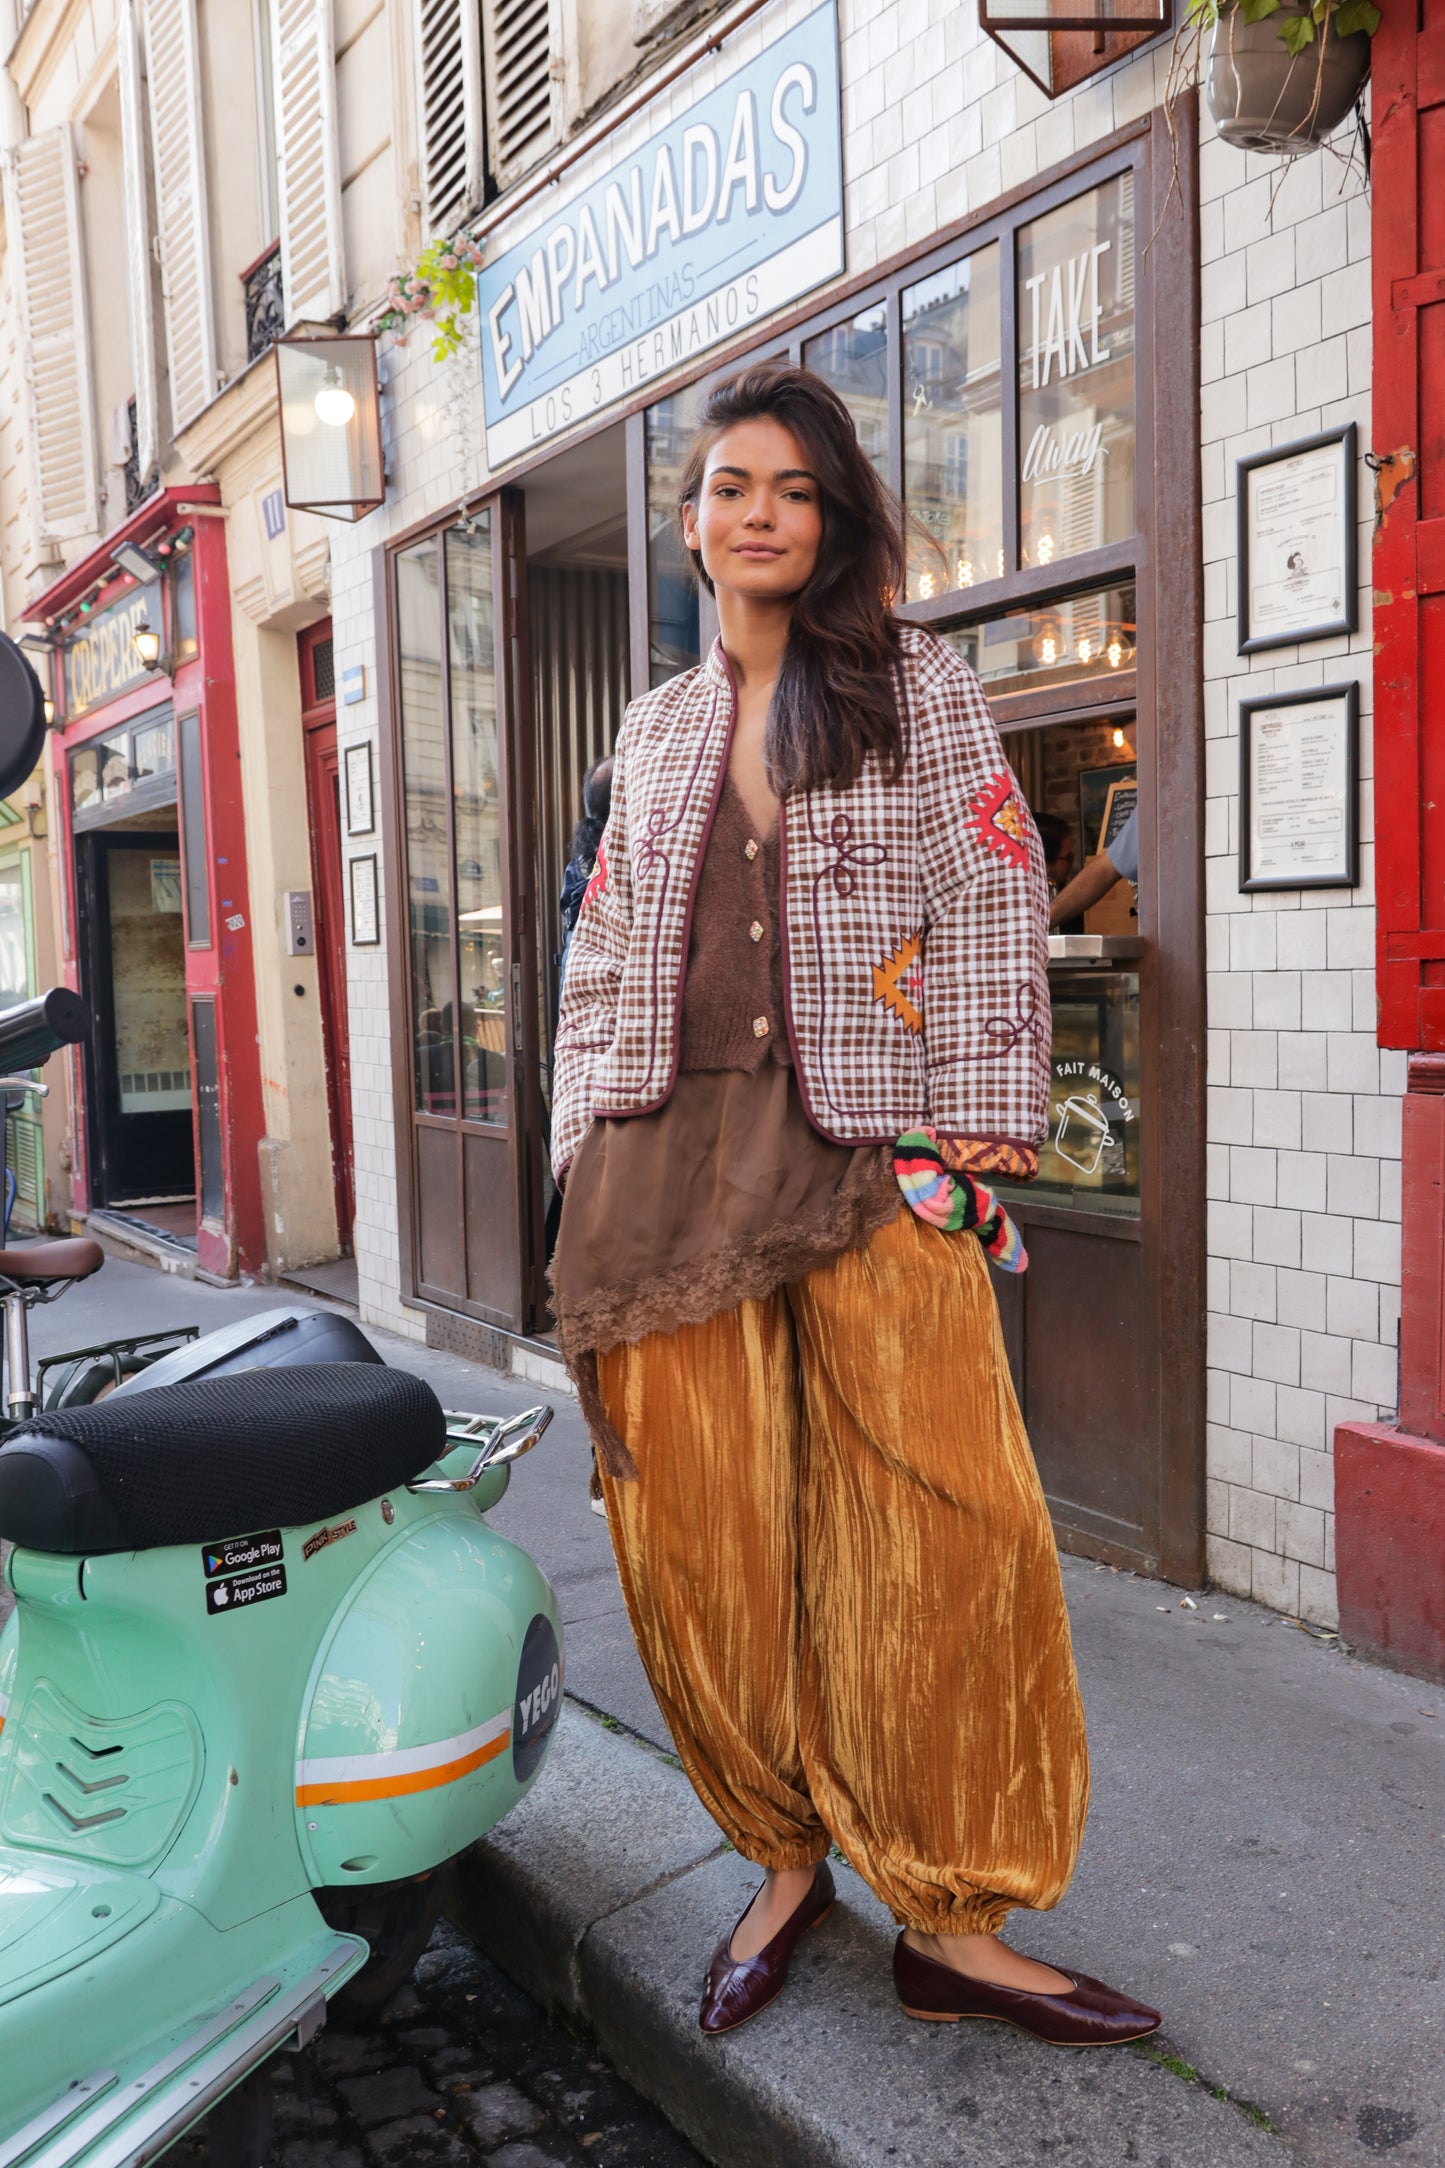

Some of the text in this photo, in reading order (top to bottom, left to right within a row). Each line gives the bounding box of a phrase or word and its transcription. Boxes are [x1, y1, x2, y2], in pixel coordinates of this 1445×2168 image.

[487, 60, 817, 403] EMPANADAS
[578, 262, 696, 366] ARGENTINAS
[1025, 240, 1112, 390] TAKE
[530, 275, 760, 440] LOS 3 HERMANOS
[1056, 1061, 1135, 1123] FAIT MAISON
[223, 1540, 249, 1551] GET IT ON
[224, 1543, 281, 1565] Google Play
[303, 1519, 357, 1558] PINK STYLE
[232, 1568, 281, 1587] Download on the
[233, 1579, 282, 1603] App Store
[519, 1662, 559, 1735] YEGO
